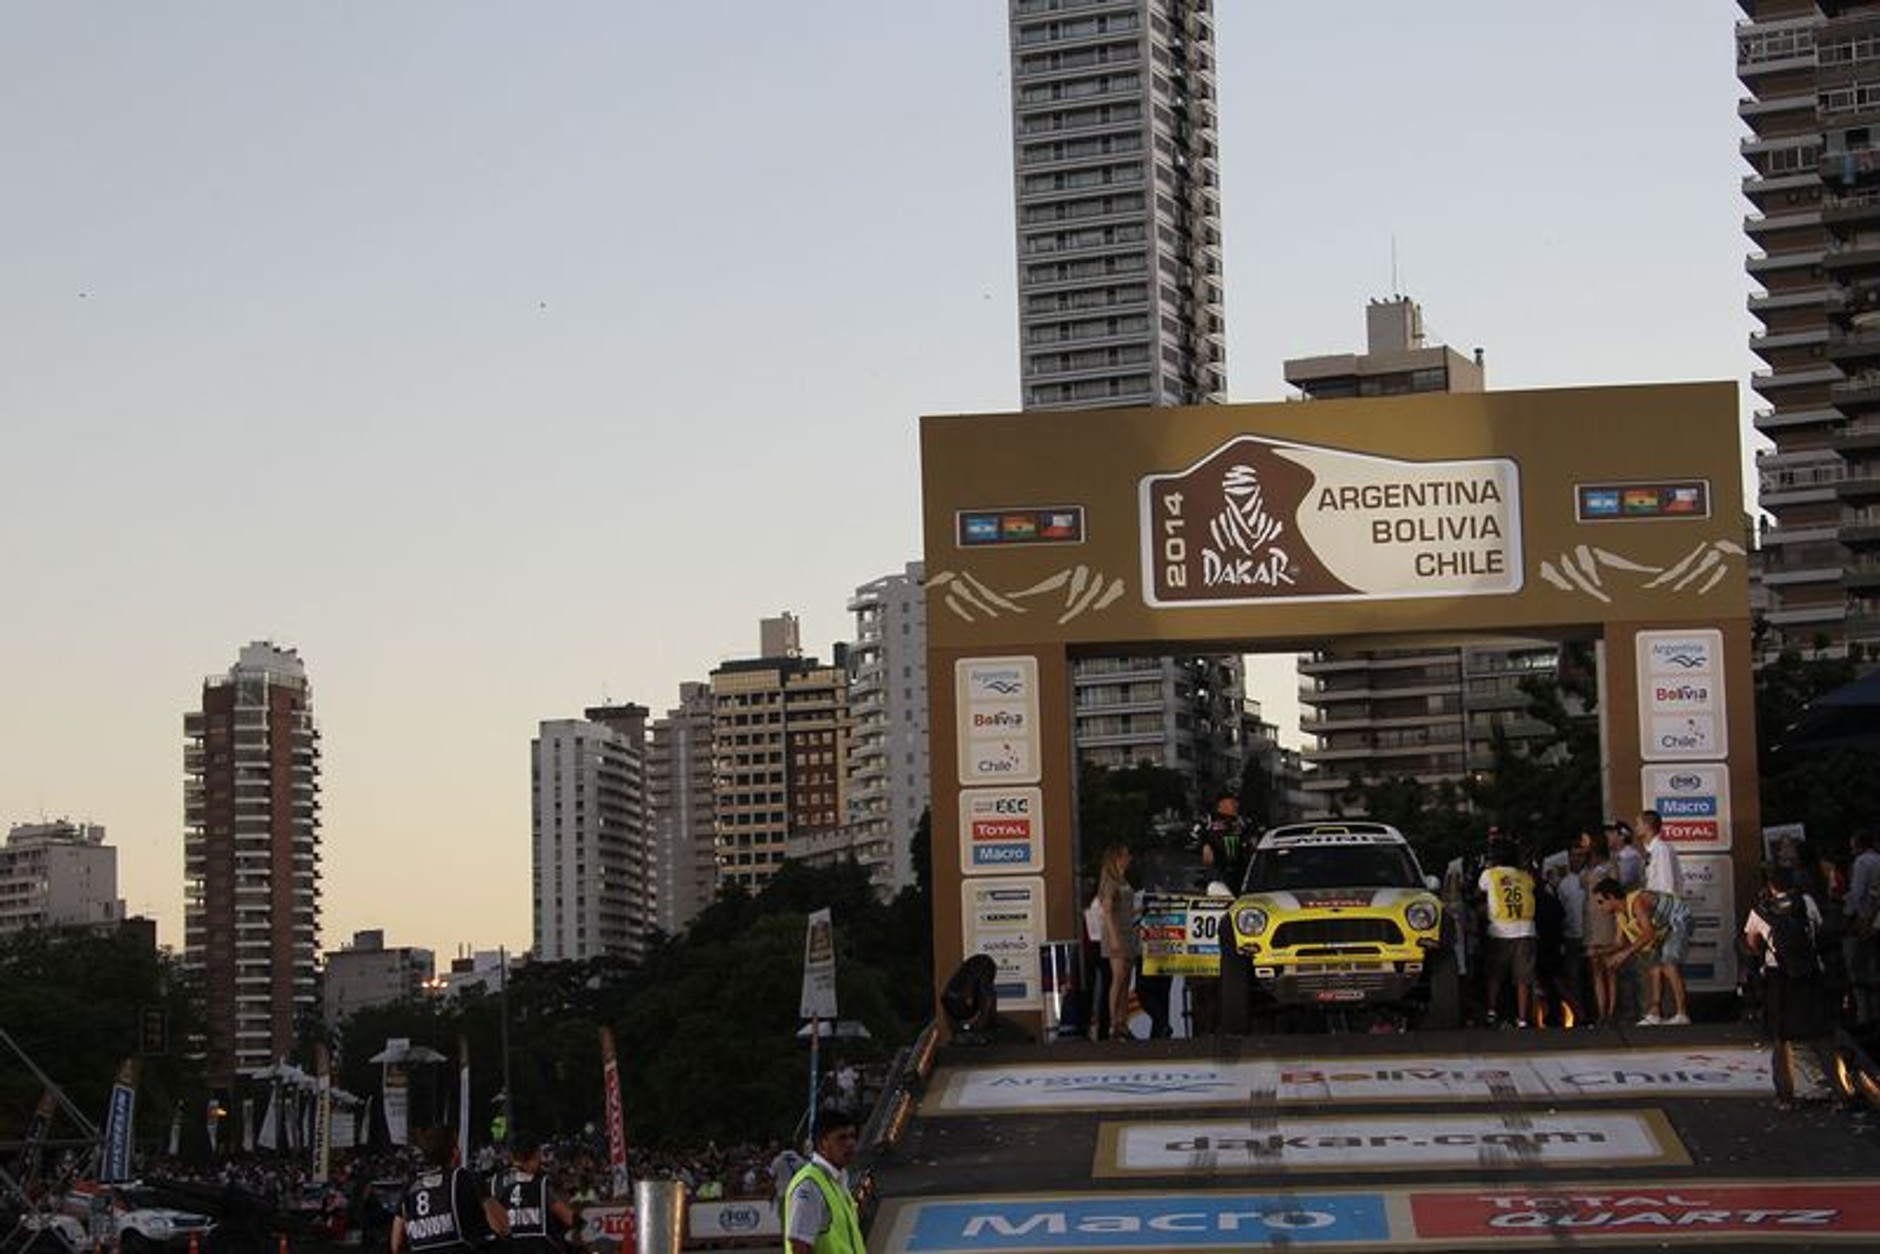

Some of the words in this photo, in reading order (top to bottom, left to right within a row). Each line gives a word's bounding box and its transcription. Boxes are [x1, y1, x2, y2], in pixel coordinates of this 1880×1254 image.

[1317, 479, 1502, 511] ARGENTINA
[1372, 514, 1501, 544] BOLIVIA
[1164, 492, 1187, 588] 2014
[1201, 547, 1296, 586] DAKAR
[1415, 549, 1504, 577] CHILE
[1663, 800, 1709, 814] Macro
[976, 824, 1026, 837] TOTAL
[1663, 824, 1714, 839] TOTAL
[980, 846, 1023, 861] Macro
[1504, 887, 1523, 903] 26
[1192, 916, 1217, 938] 30
[989, 1071, 1219, 1088] Argentina
[1281, 1067, 1512, 1085] Bolivia
[416, 1190, 430, 1216] 8
[962, 1210, 1337, 1238] Macro
[1489, 1208, 1838, 1229] QUARTZ
